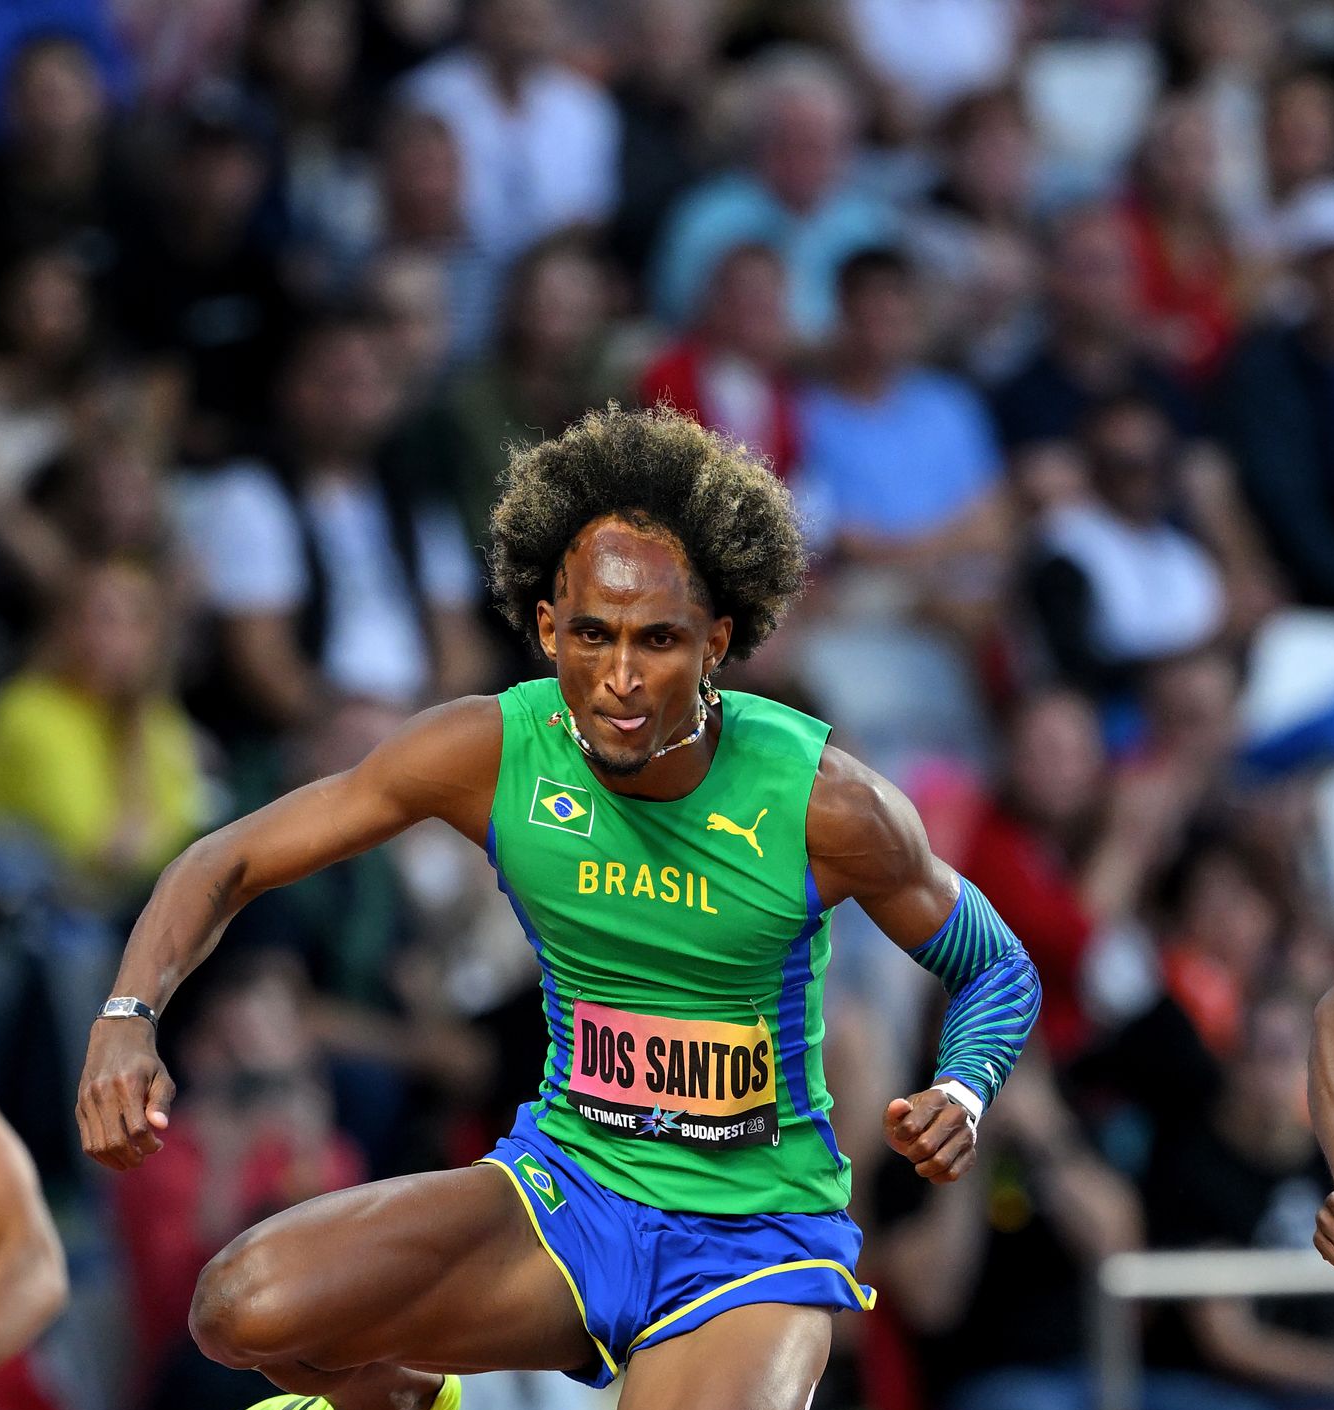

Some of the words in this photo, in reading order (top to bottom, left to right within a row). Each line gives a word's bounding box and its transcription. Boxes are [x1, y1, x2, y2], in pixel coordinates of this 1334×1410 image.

[578, 860, 718, 915] BRASIL
[581, 1018, 635, 1089] DOS
[645, 1034, 769, 1101] SANTOS
[579, 1104, 637, 1130] ULTIMATE
[681, 1121, 746, 1142] BUDAPEST
[746, 1116, 766, 1133] 26
